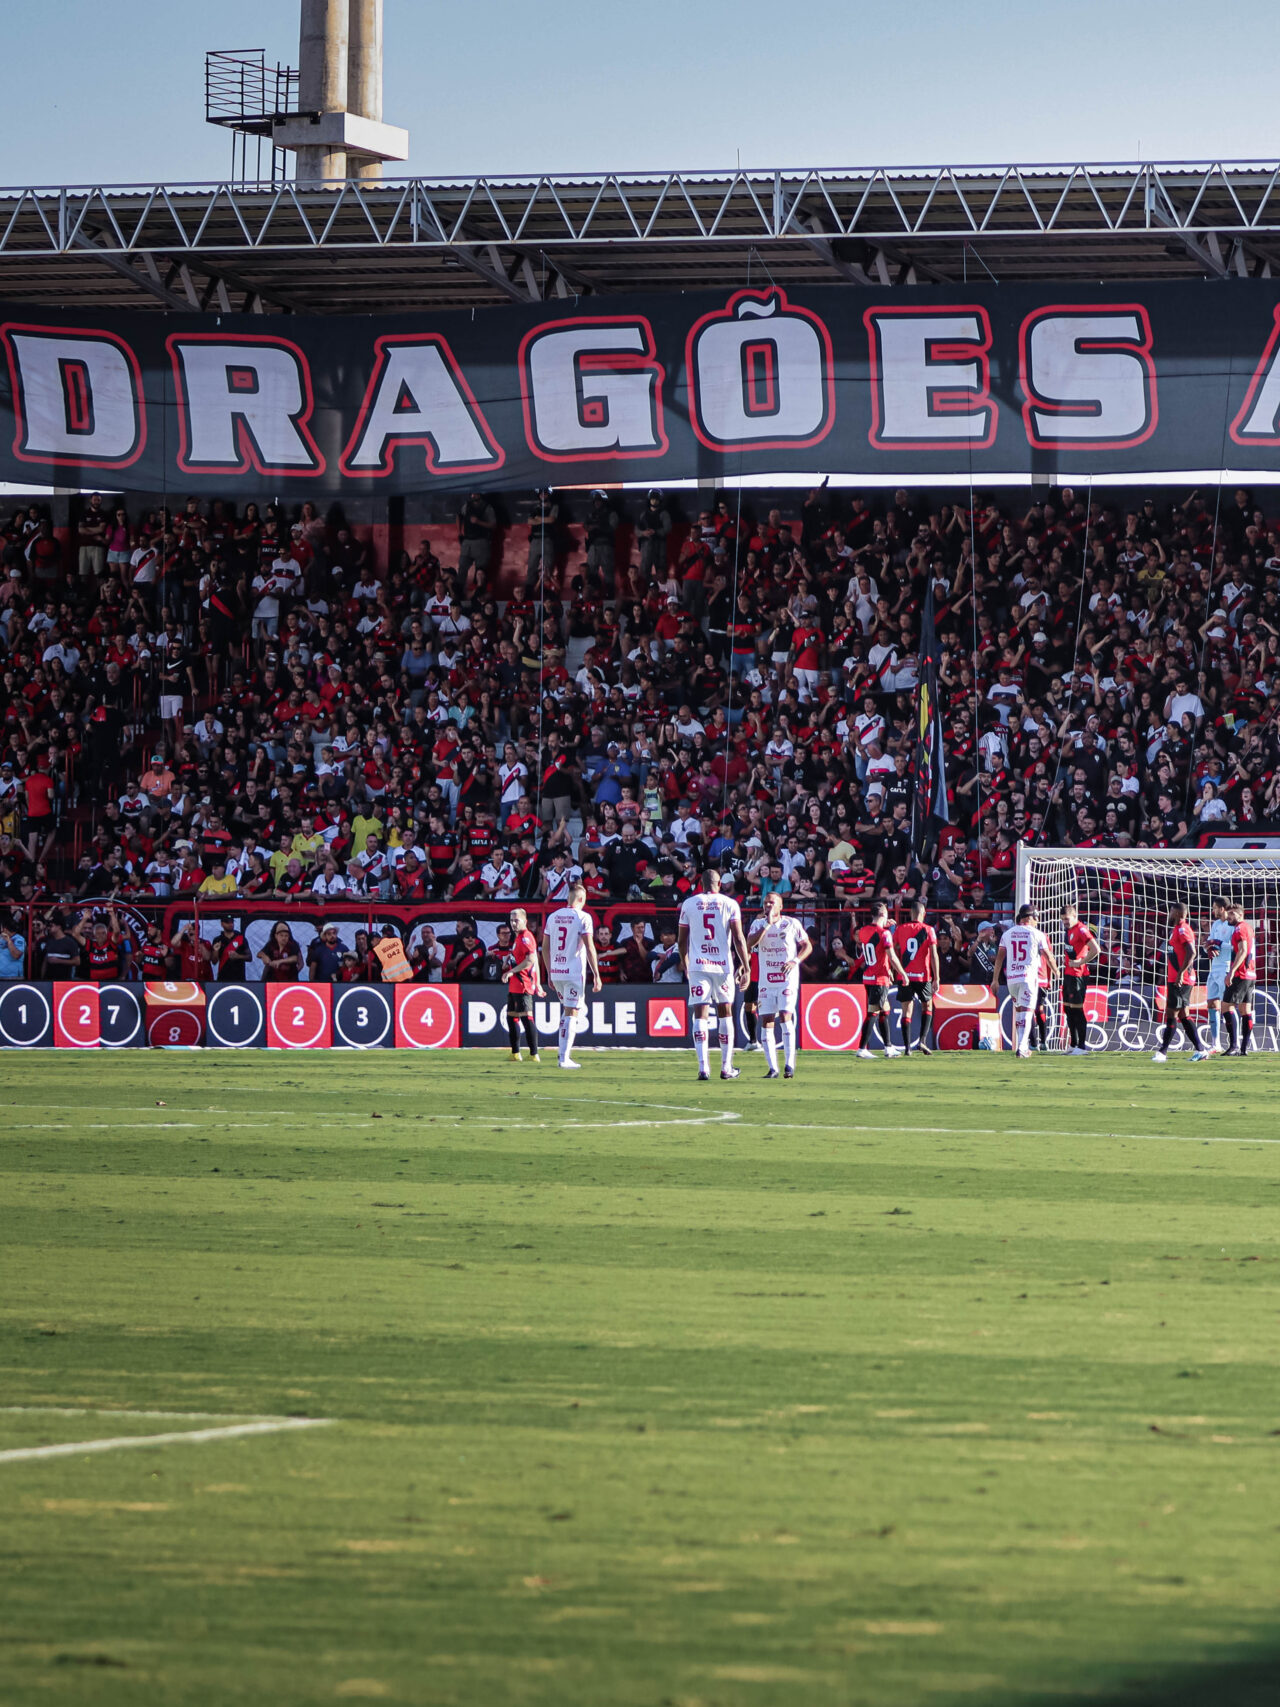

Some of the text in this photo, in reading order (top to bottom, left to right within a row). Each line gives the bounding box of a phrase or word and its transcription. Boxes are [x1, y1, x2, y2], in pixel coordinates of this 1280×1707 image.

[4, 288, 1158, 478] DRAGÕES
[557, 926, 568, 950] 3
[703, 913, 716, 940] 5
[701, 943, 720, 954] Sim
[861, 942, 877, 966] 10
[907, 937, 918, 961] 9
[1010, 940, 1028, 962] 15
[690, 985, 704, 998] F8
[18, 1004, 434, 1042] 1 2 7 8 1 2 3 4
[828, 1008, 841, 1028] 6
[957, 1031, 970, 1047] 8
